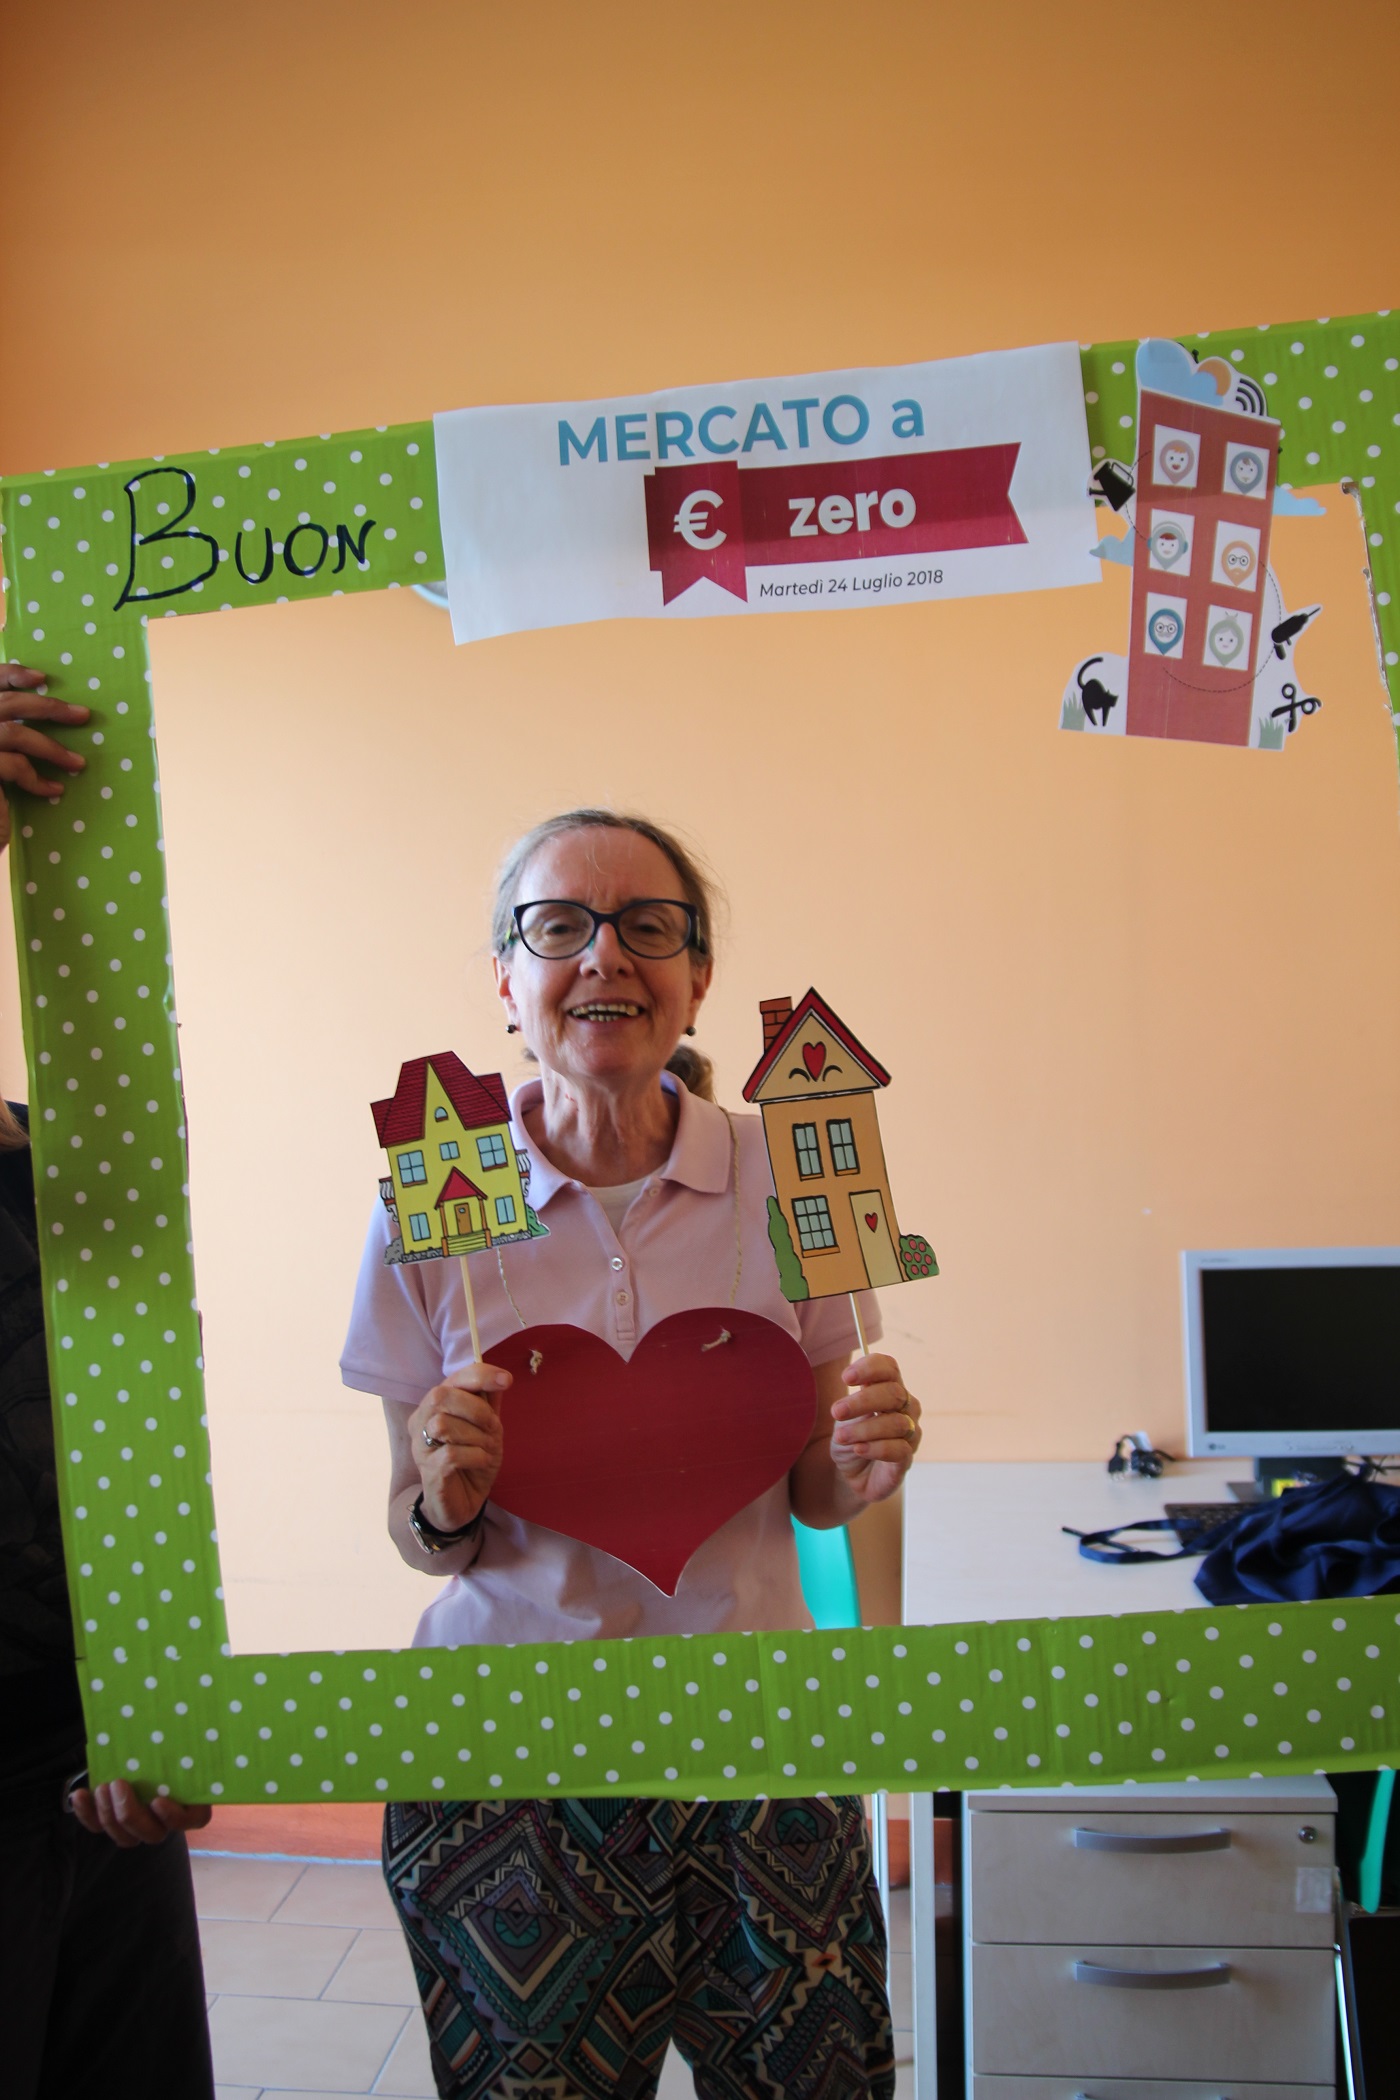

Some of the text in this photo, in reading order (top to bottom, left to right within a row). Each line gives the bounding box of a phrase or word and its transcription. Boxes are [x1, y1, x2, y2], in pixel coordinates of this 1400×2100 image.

[558, 395, 925, 466] MERCATO a
[113, 467, 376, 612] BUON
[673, 487, 917, 551] € zero
[759, 569, 944, 598] Martedì 24 Luglio 2018
